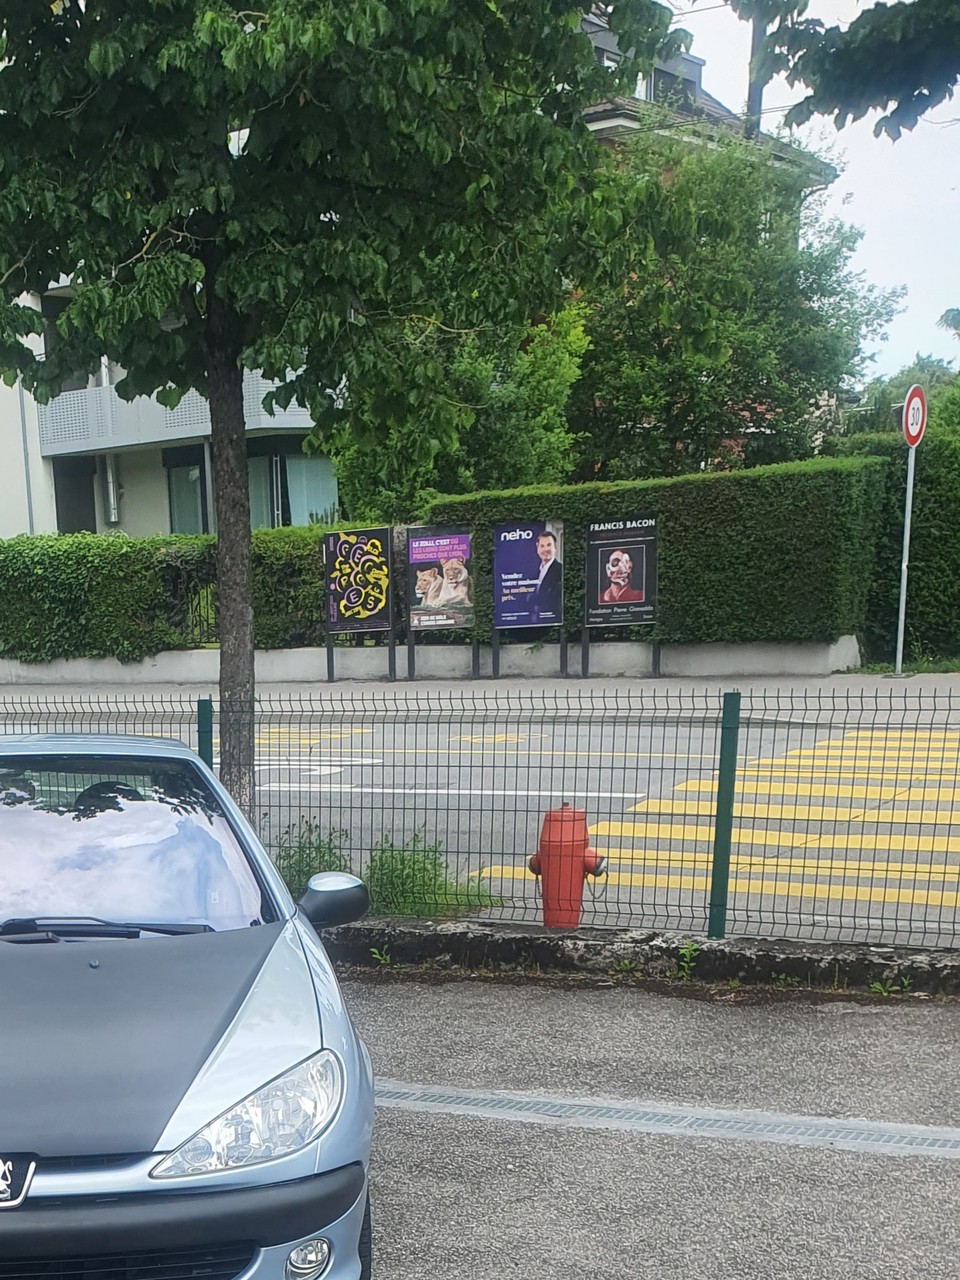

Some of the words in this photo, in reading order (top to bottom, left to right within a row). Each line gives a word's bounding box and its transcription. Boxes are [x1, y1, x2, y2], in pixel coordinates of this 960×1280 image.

[910, 406, 920, 426] 30
[590, 521, 623, 531] FRANCIS
[626, 518, 655, 528] BACON
[501, 529, 533, 541] neho
